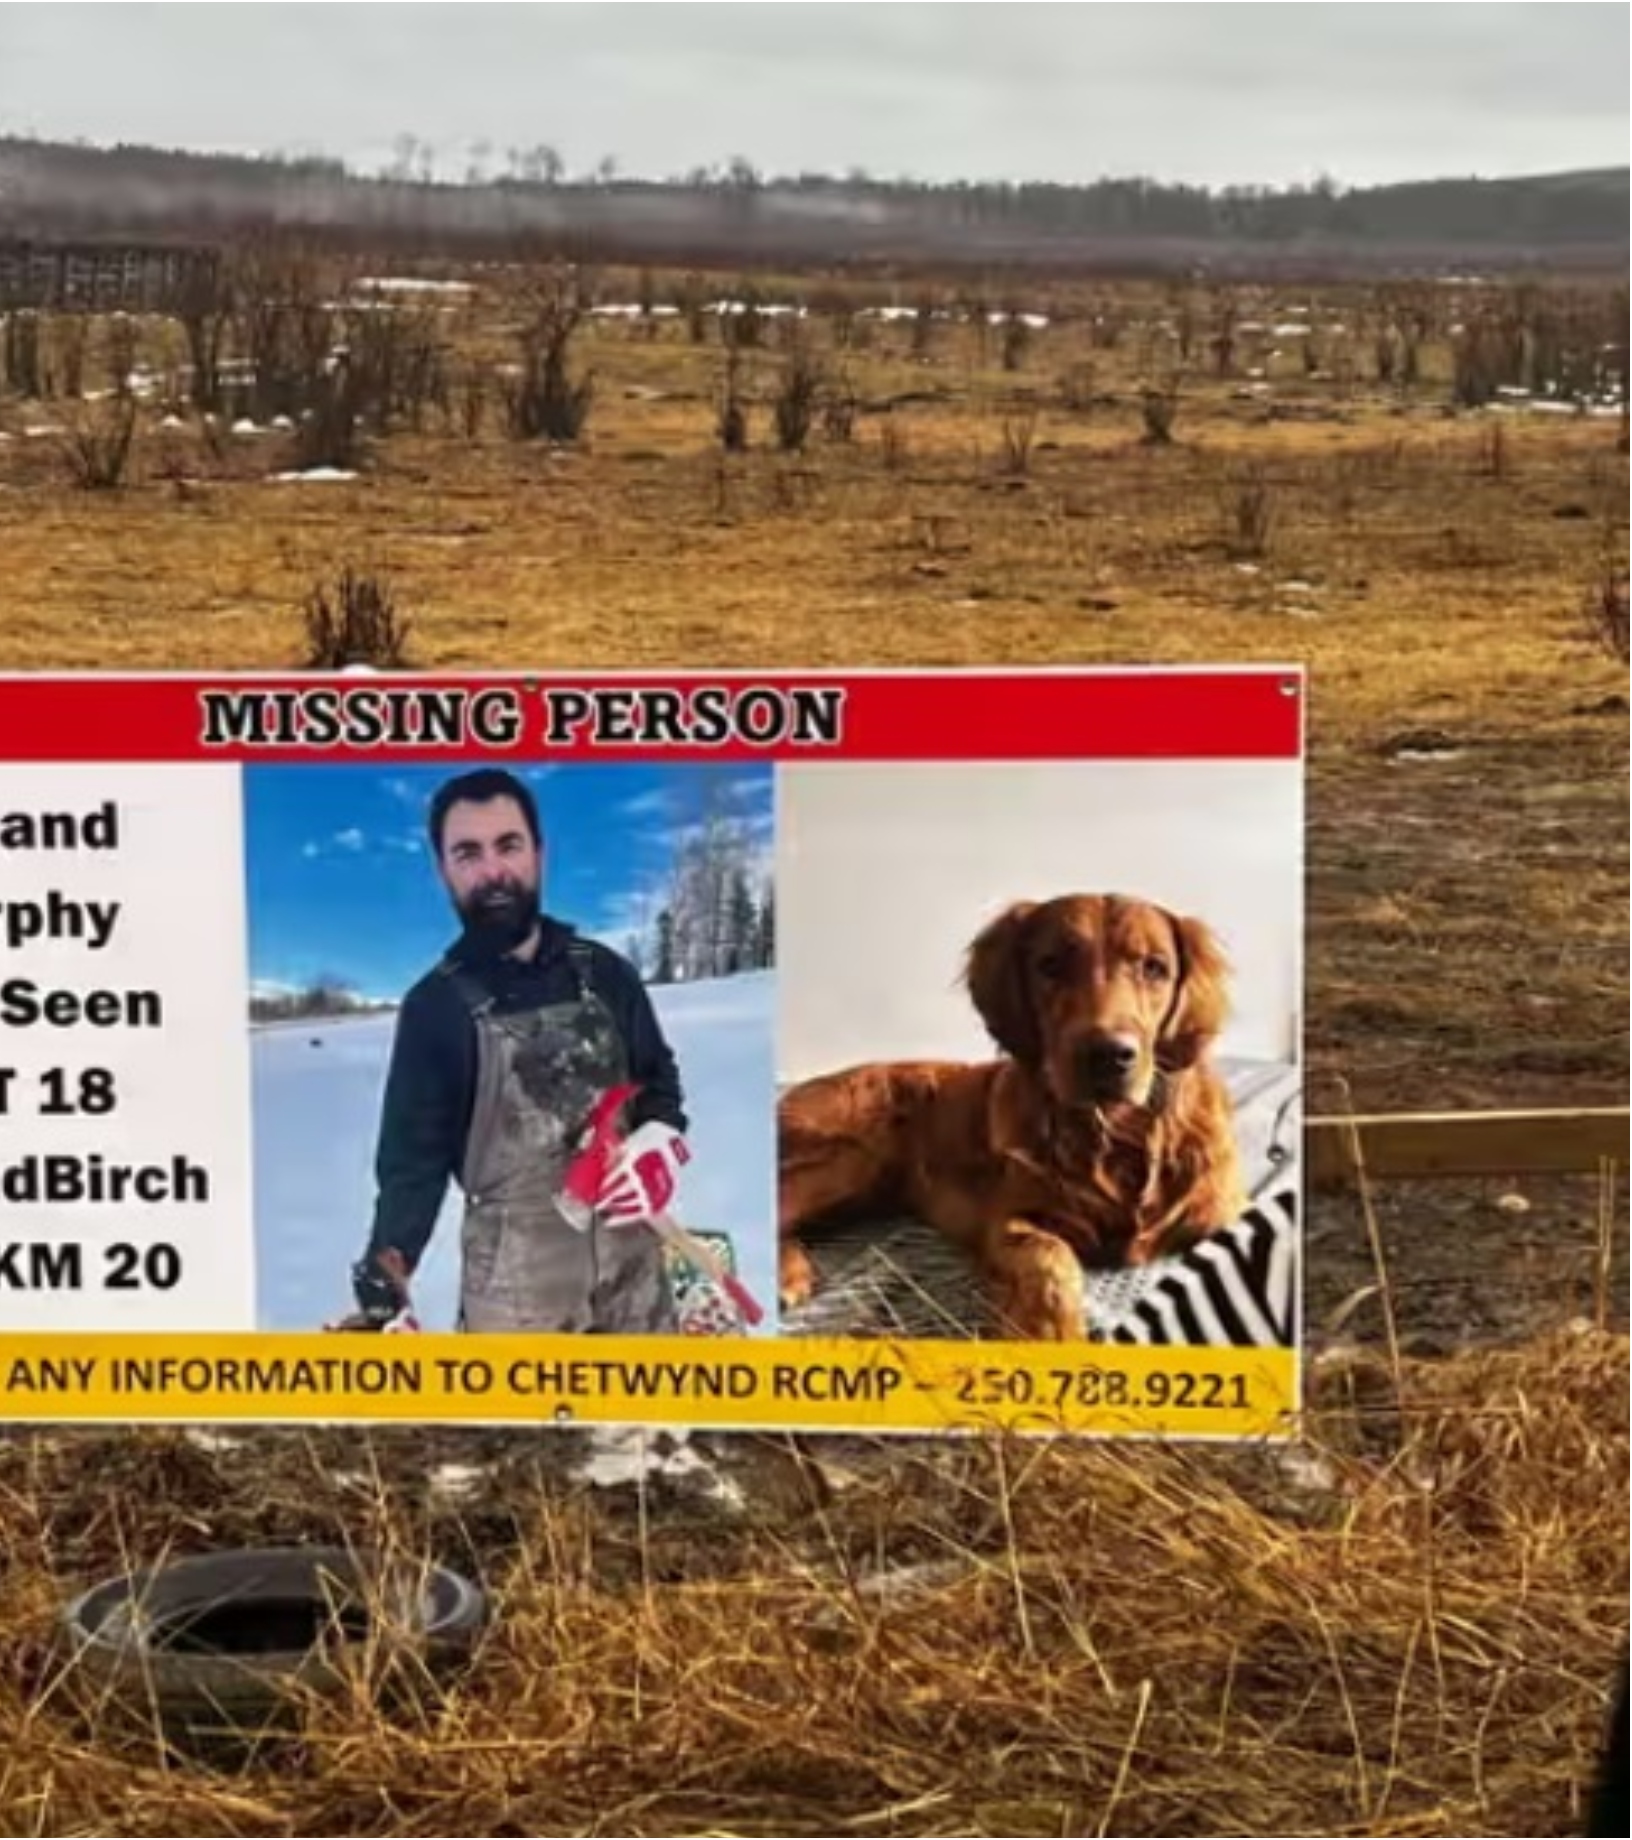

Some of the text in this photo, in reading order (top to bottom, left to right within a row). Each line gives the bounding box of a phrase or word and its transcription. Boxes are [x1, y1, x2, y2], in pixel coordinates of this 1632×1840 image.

[201, 687, 844, 745] MISSING PERSON
[0, 801, 118, 850] and
[0, 978, 162, 1027] Seen
[39, 1067, 116, 1115] 18
[104, 1242, 181, 1291] 20
[6, 1358, 95, 1392] ANY
[111, 1358, 421, 1393] INFORMATION
[436, 1360, 493, 1394] TO
[507, 1360, 757, 1398] CHETWYND
[773, 1365, 902, 1402] RCMP
